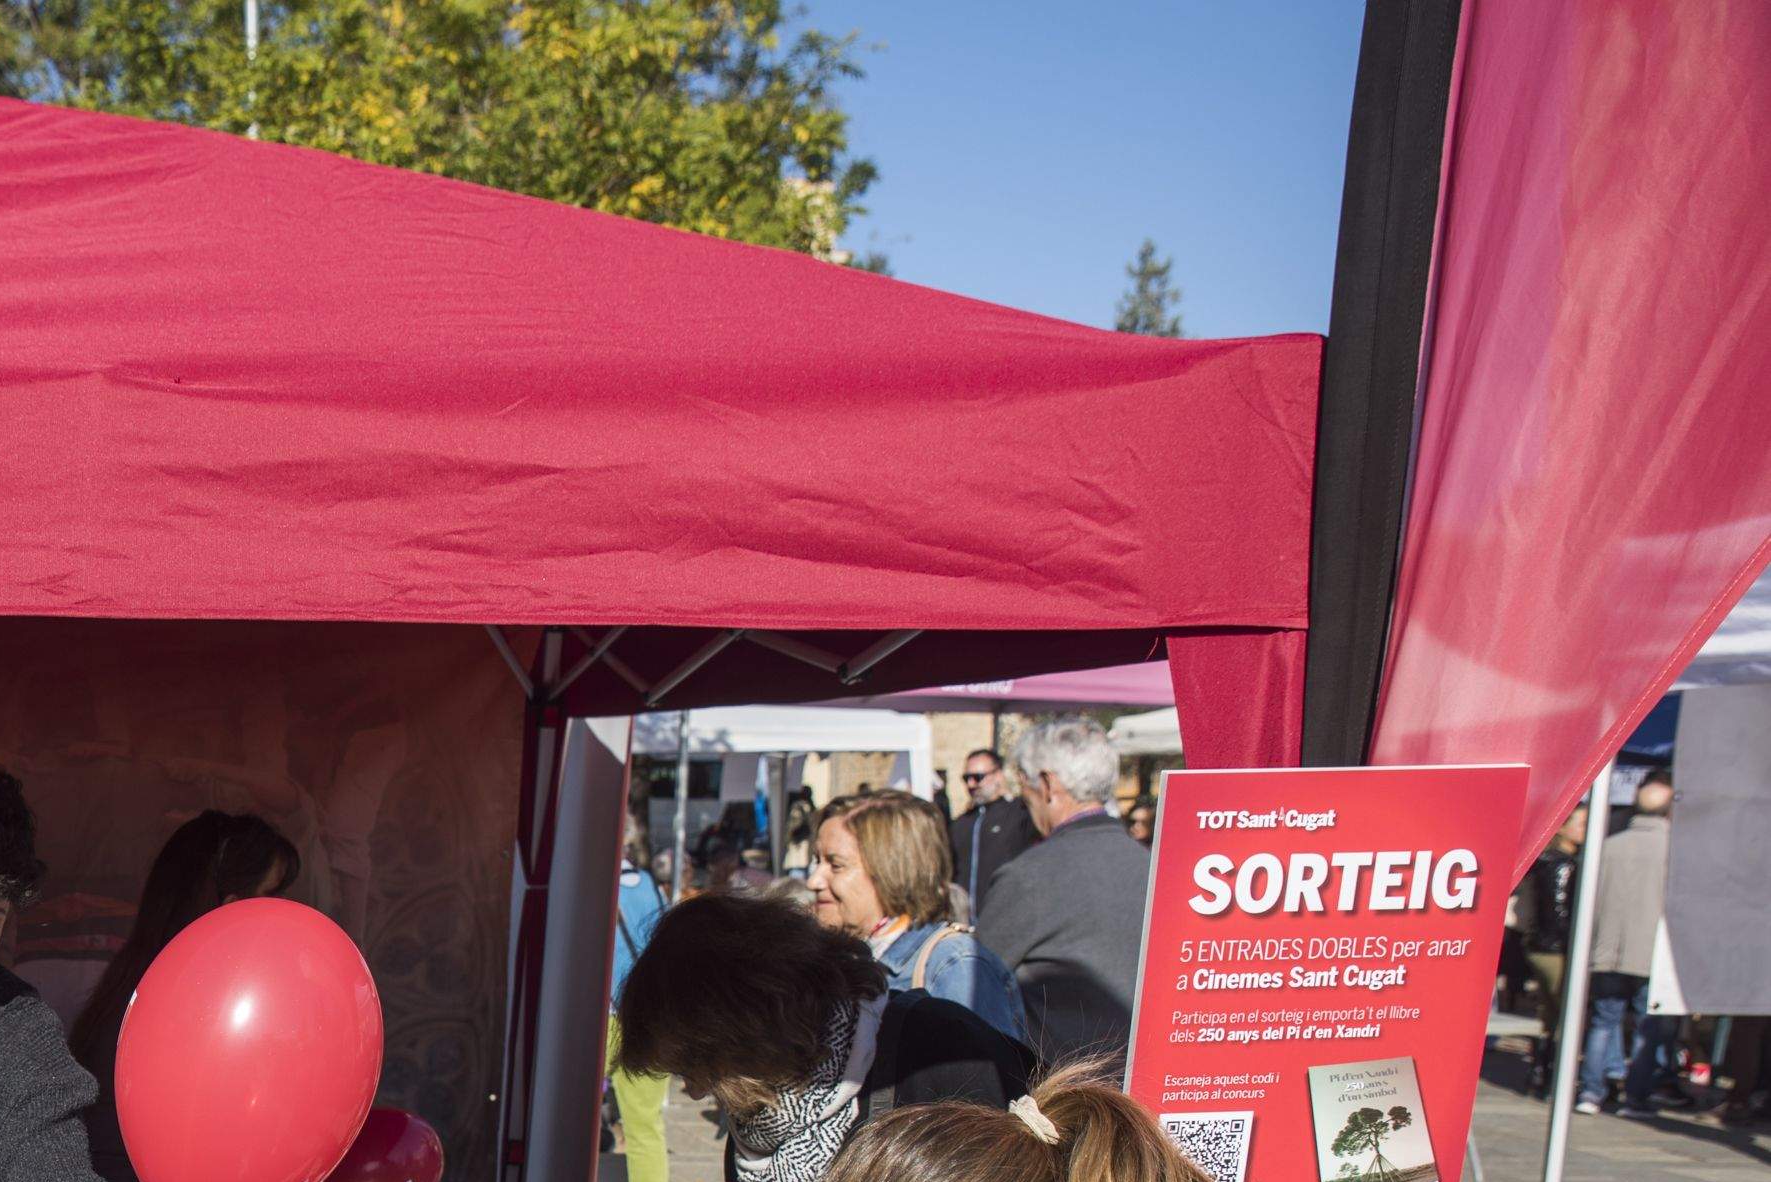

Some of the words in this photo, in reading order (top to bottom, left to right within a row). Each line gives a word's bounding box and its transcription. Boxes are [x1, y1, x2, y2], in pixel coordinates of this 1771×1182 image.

[1197, 810, 1237, 829] TOT
[1237, 810, 1278, 829] Sant
[1284, 808, 1336, 832] Cugat
[1188, 848, 1478, 916] SORTEIG
[1179, 940, 1193, 963] 5
[1198, 937, 1303, 962] ENTRADES
[1308, 936, 1388, 960] DOBLES
[1391, 939, 1424, 962] per
[1427, 938, 1471, 957] anar
[1176, 974, 1188, 991] a
[1193, 968, 1284, 991] Cinemes
[1288, 966, 1338, 988] Sant
[1343, 964, 1407, 991] Cugat
[1171, 1010, 1228, 1026] Participa
[1229, 1011, 1245, 1023] en
[1247, 1009, 1259, 1022] el
[1261, 1007, 1303, 1025] sorteig
[1306, 1008, 1311, 1021] i
[1312, 1006, 1375, 1024] emporta't
[1376, 1005, 1388, 1019] el
[1389, 1005, 1421, 1019] llibre
[1169, 1029, 1196, 1043] dels
[1197, 1028, 1225, 1042] 250
[1226, 1029, 1260, 1044] anys
[1262, 1026, 1284, 1040] del
[1286, 1025, 1300, 1039] Pi
[1334, 1023, 1381, 1038] Xandri
[1164, 1074, 1212, 1088] Escaneja
[1213, 1074, 1251, 1088] aquest
[1251, 1072, 1276, 1085] codi
[1275, 1072, 1280, 1084] i
[1162, 1089, 1210, 1103] participa
[1211, 1089, 1221, 1100] al
[1222, 1088, 1266, 1100] concurs
